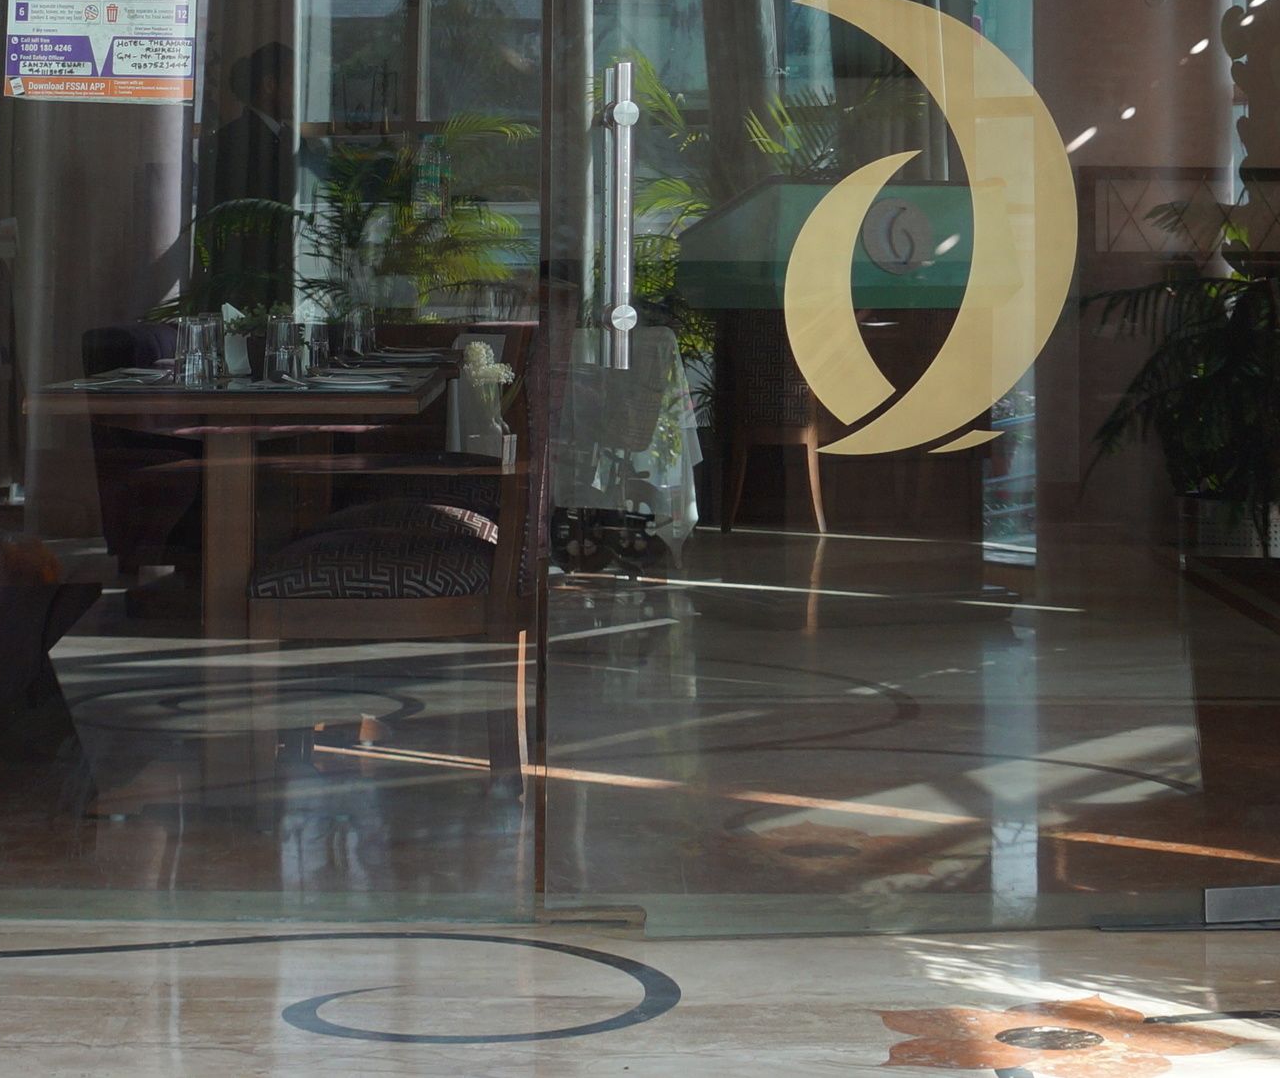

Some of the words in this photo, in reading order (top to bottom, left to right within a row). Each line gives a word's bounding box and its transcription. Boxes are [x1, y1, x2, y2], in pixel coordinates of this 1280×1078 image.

[19, 7, 25, 16] 6
[178, 10, 187, 19] 12
[28, 82, 64, 90] Download
[65, 82, 88, 91] FSSAI
[90, 83, 105, 91] APP
